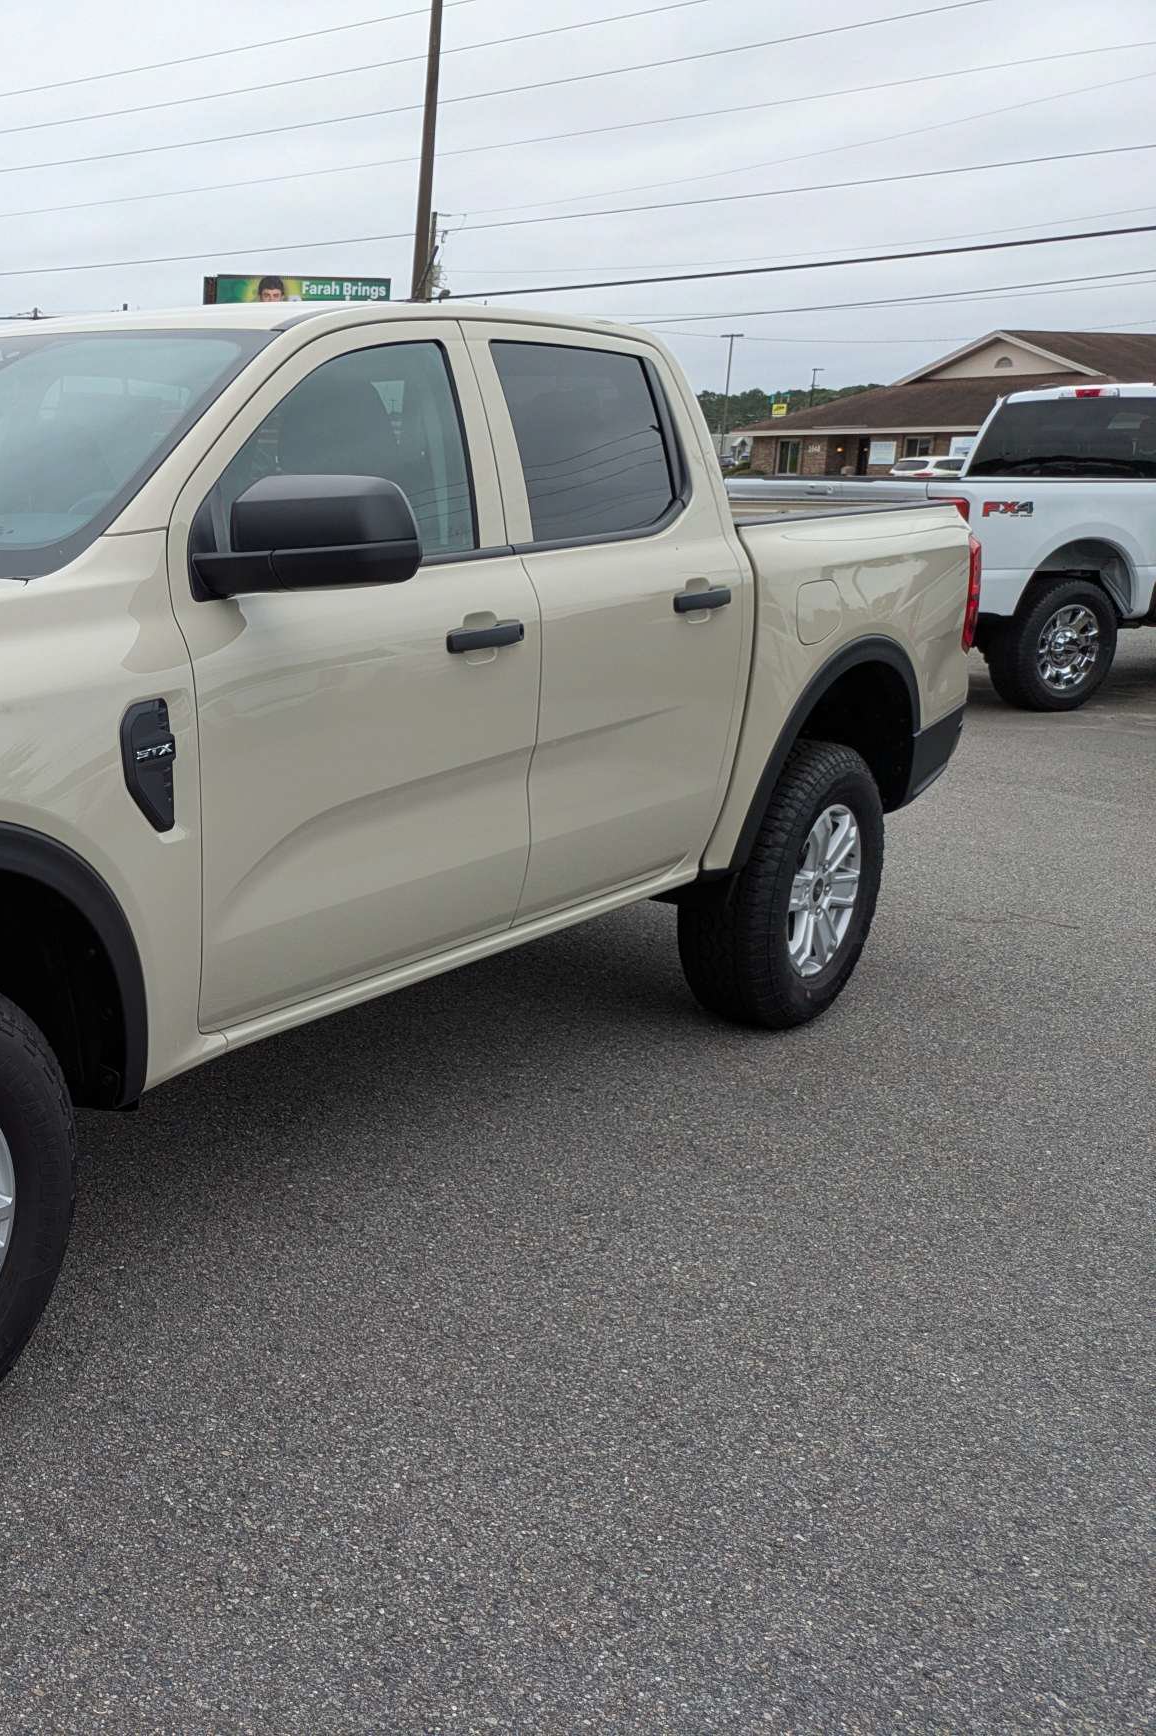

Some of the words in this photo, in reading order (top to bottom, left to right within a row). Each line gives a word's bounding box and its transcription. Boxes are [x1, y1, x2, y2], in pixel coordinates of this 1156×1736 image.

[301, 281, 340, 296] Farah
[343, 282, 387, 299] Brings
[981, 501, 1034, 517] FX4
[135, 742, 174, 760] STX
